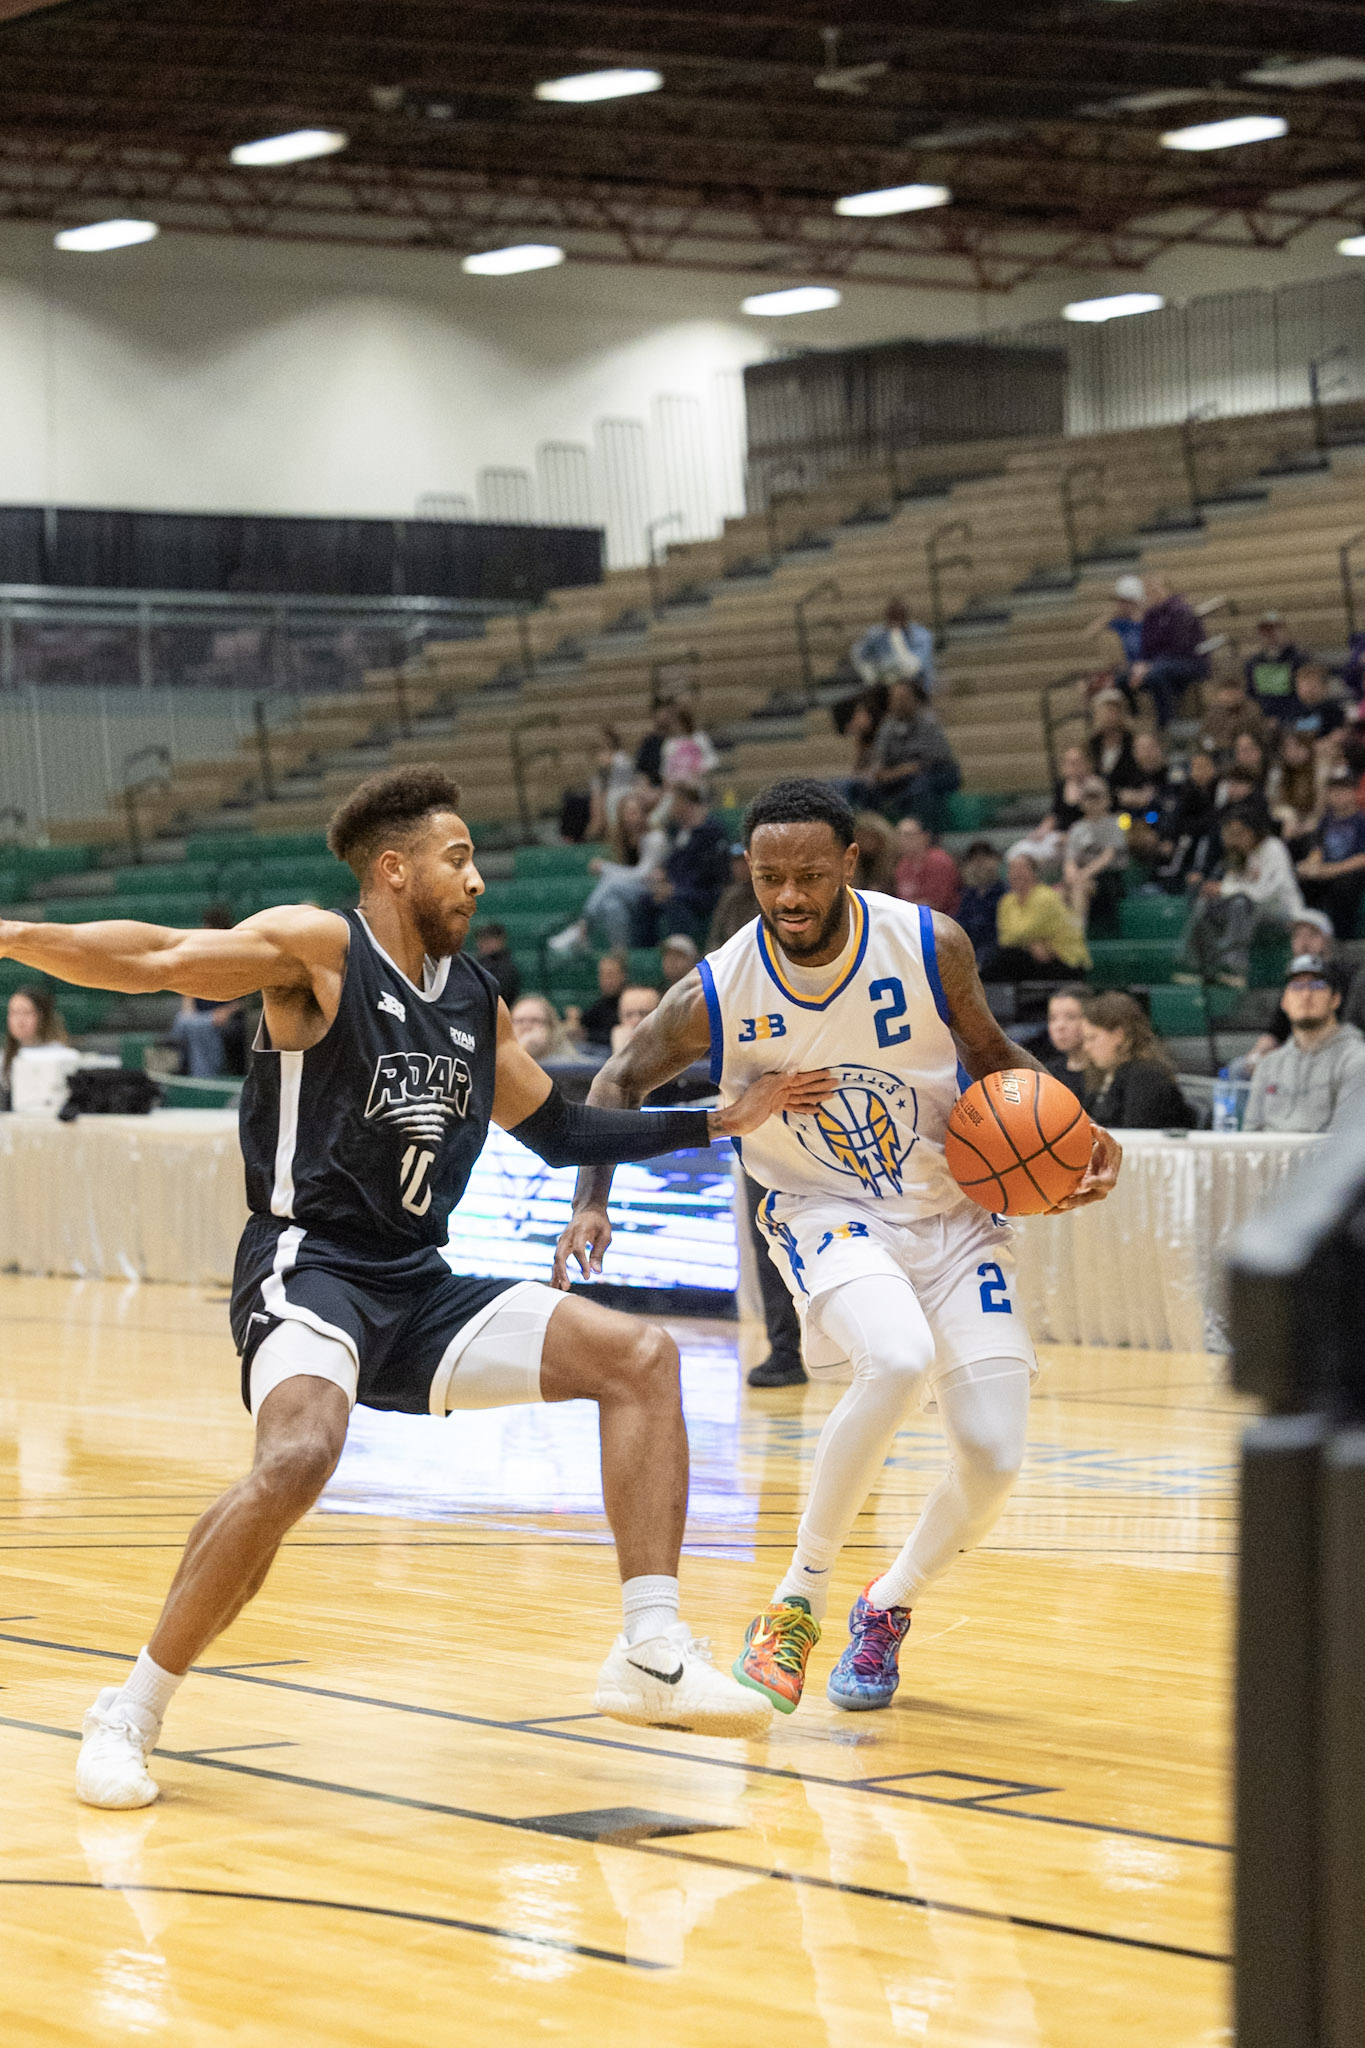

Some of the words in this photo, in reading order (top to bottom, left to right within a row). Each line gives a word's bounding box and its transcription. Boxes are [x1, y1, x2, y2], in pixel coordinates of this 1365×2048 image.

[449, 1026, 475, 1047] RYAN
[869, 977, 911, 1048] 2
[364, 1052, 472, 1119] ROAR
[977, 1262, 1013, 1314] 2
